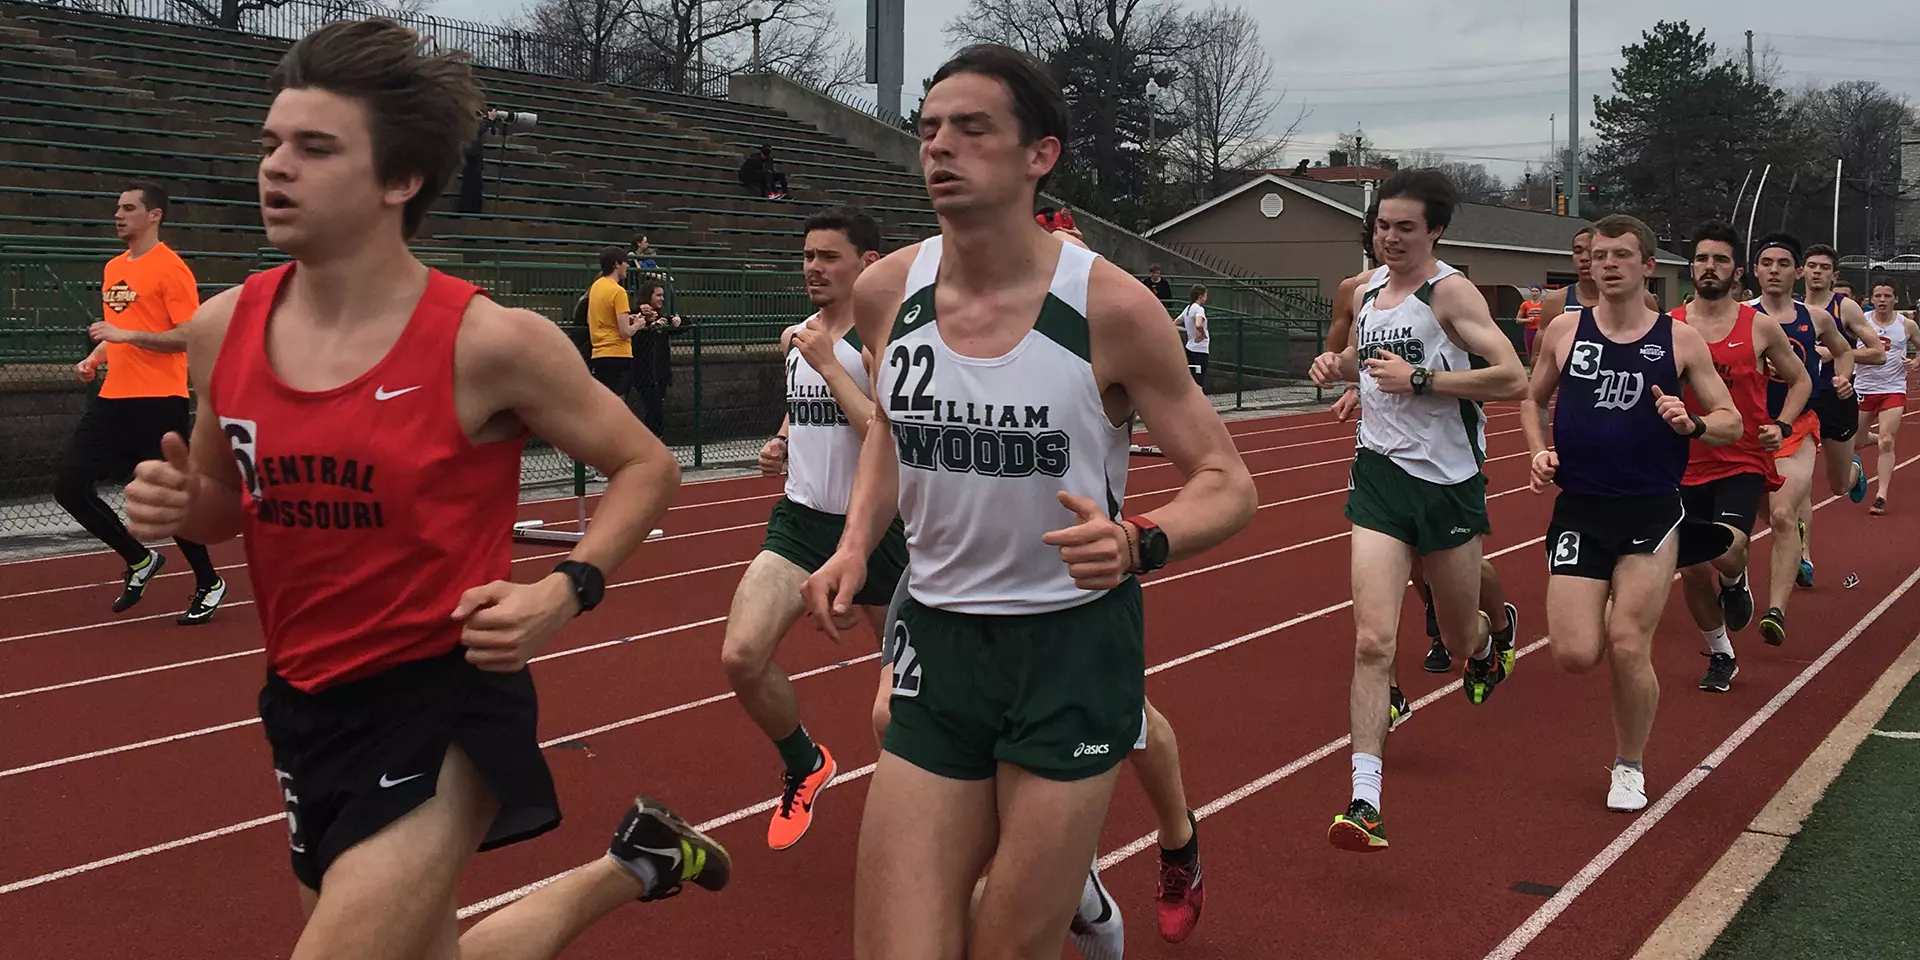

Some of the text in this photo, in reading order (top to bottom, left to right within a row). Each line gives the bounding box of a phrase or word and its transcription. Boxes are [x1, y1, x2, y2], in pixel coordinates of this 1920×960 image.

[1364, 326, 1412, 343] ILLIAM
[1571, 344, 1600, 376] 3
[890, 344, 935, 411] 22
[903, 400, 1049, 428] ILLIAM
[891, 420, 1071, 478] WOODS
[1556, 533, 1577, 562] 3
[1082, 743, 1110, 756] asics
